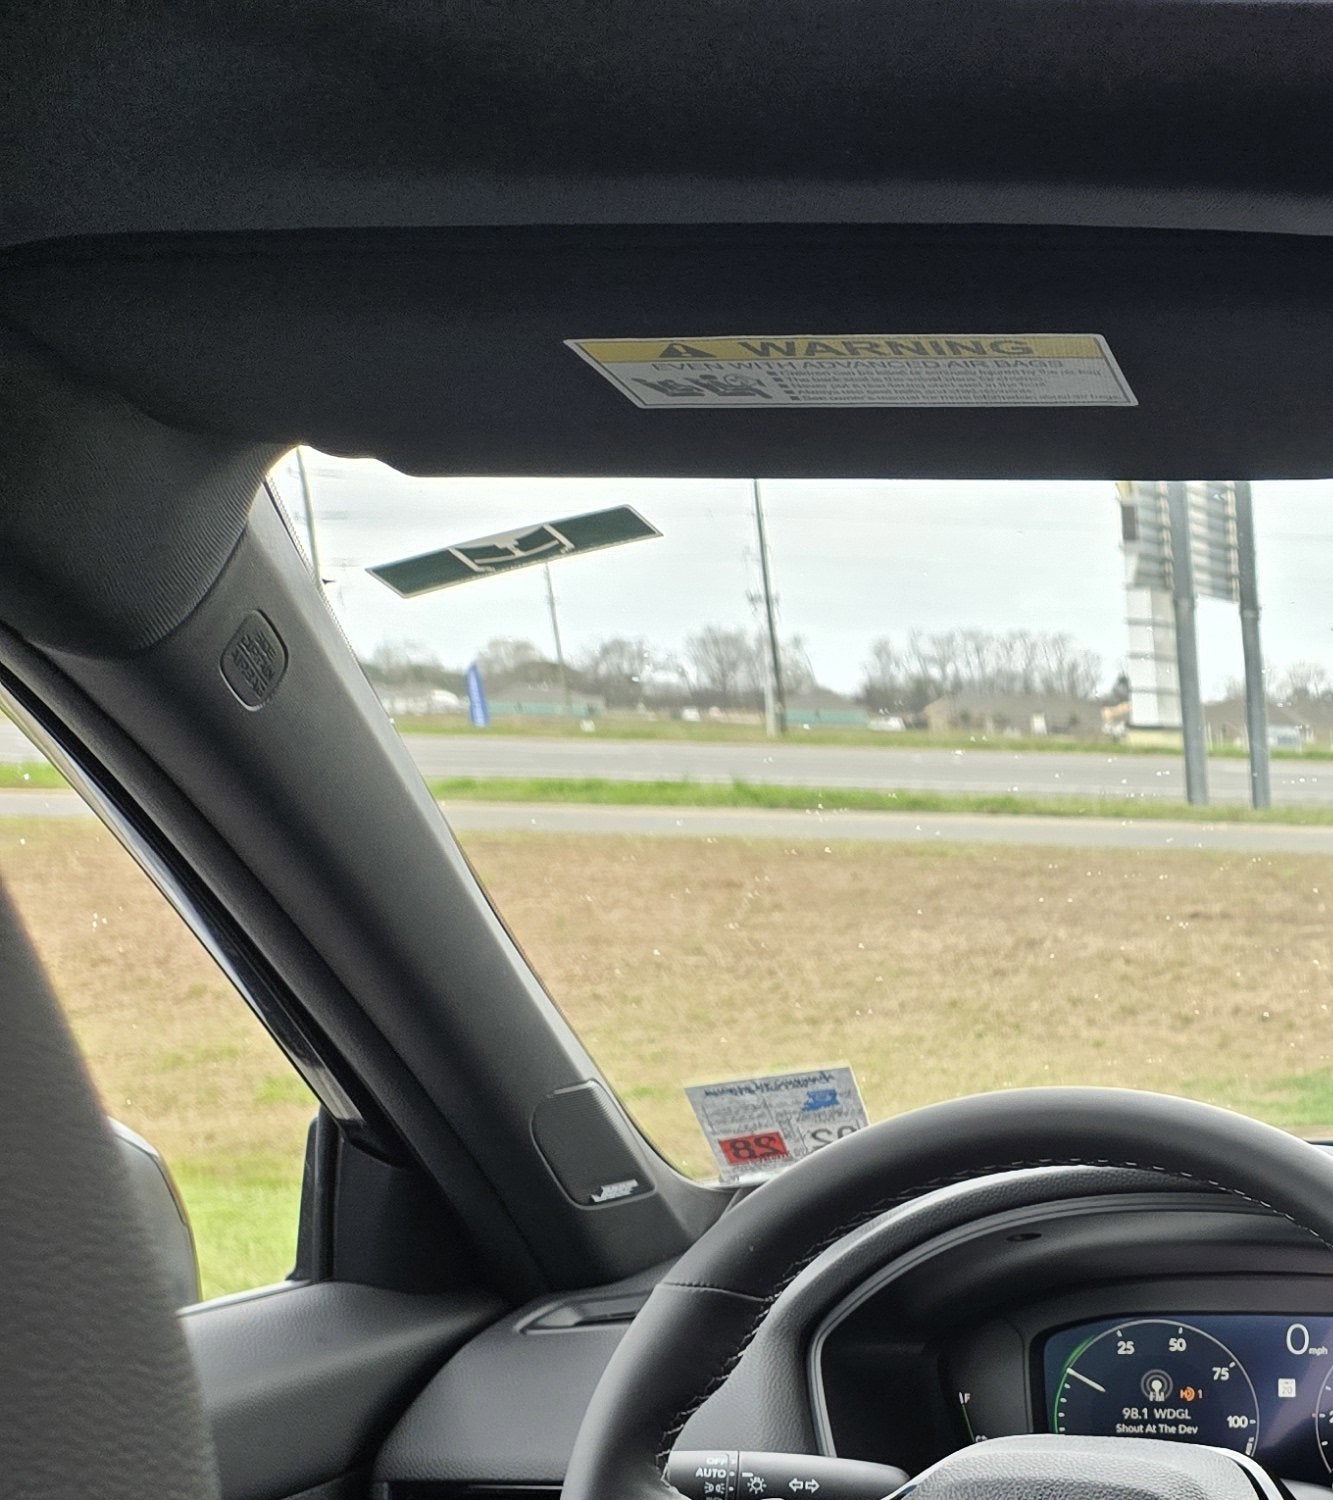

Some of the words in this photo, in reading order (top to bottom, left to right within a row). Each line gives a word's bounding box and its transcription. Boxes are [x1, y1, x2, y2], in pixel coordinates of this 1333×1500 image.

[737, 339, 1033, 357] WARNING
[651, 361, 723, 372] EVEN
[726, 361, 797, 371] WITH
[801, 359, 945, 370] ADVANCED
[947, 359, 990, 369] AIR
[1168, 1338, 1187, 1352] 50
[1286, 1323, 1310, 1355] 0
[1309, 1346, 1329, 1356] mph
[1117, 1341, 1135, 1355] 25
[1212, 1367, 1230, 1381] 75
[1122, 1408, 1148, 1420] 98.1
[1153, 1408, 1191, 1420] WDGL
[1116, 1424, 1144, 1434] Shout
[1145, 1424, 1157, 1434] At
[1158, 1424, 1177, 1434] The
[1178, 1424, 1199, 1434] Dev
[1226, 1416, 1248, 1429] 100
[695, 1467, 726, 1479] AUTO
